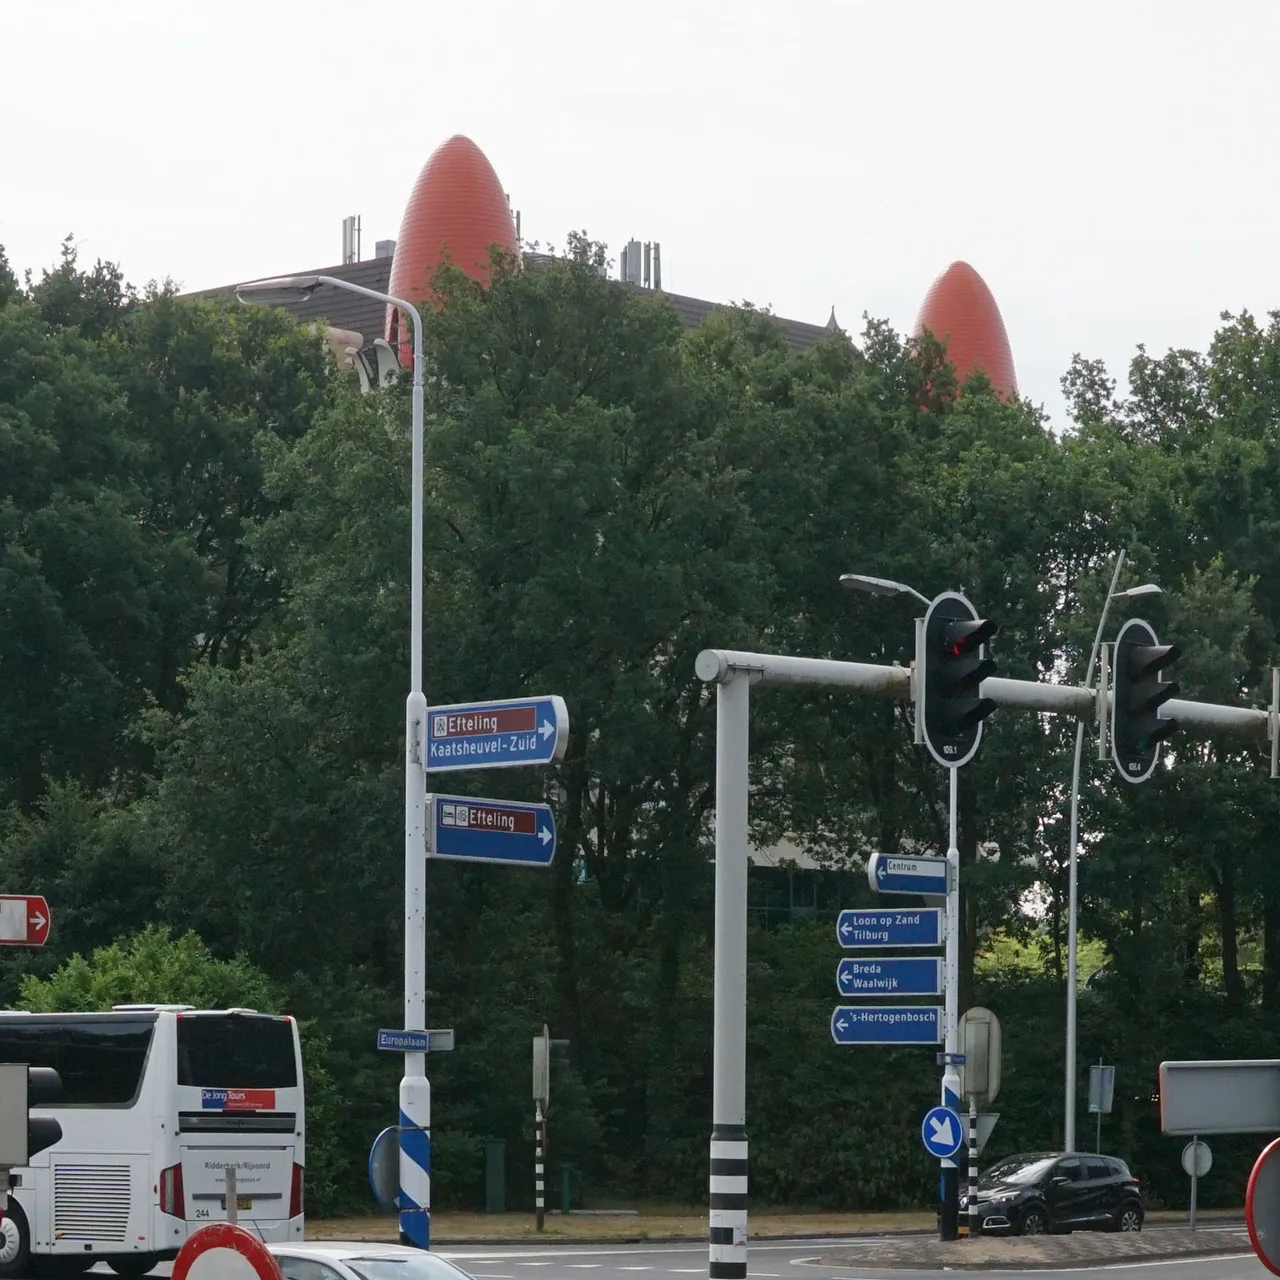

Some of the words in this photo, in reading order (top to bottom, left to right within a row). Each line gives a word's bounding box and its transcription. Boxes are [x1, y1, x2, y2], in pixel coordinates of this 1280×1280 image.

[449, 716, 498, 733] Efteling
[431, 735, 537, 758] Kaatsheuvel-Zuid
[470, 810, 515, 831] Efteling
[888, 861, 918, 872] Centrum
[853, 916, 877, 926] Loon
[880, 916, 892, 927] op
[895, 915, 920, 925] Zand
[854, 930, 888, 942] Tilburg
[853, 965, 881, 974] Breda
[853, 978, 898, 990] Waalwijk
[850, 1012, 936, 1025] 's-Hertogenbosch
[381, 1034, 426, 1047] Europalaan
[228, 1091, 246, 1100] Tours
[196, 1209, 210, 1218] 244
